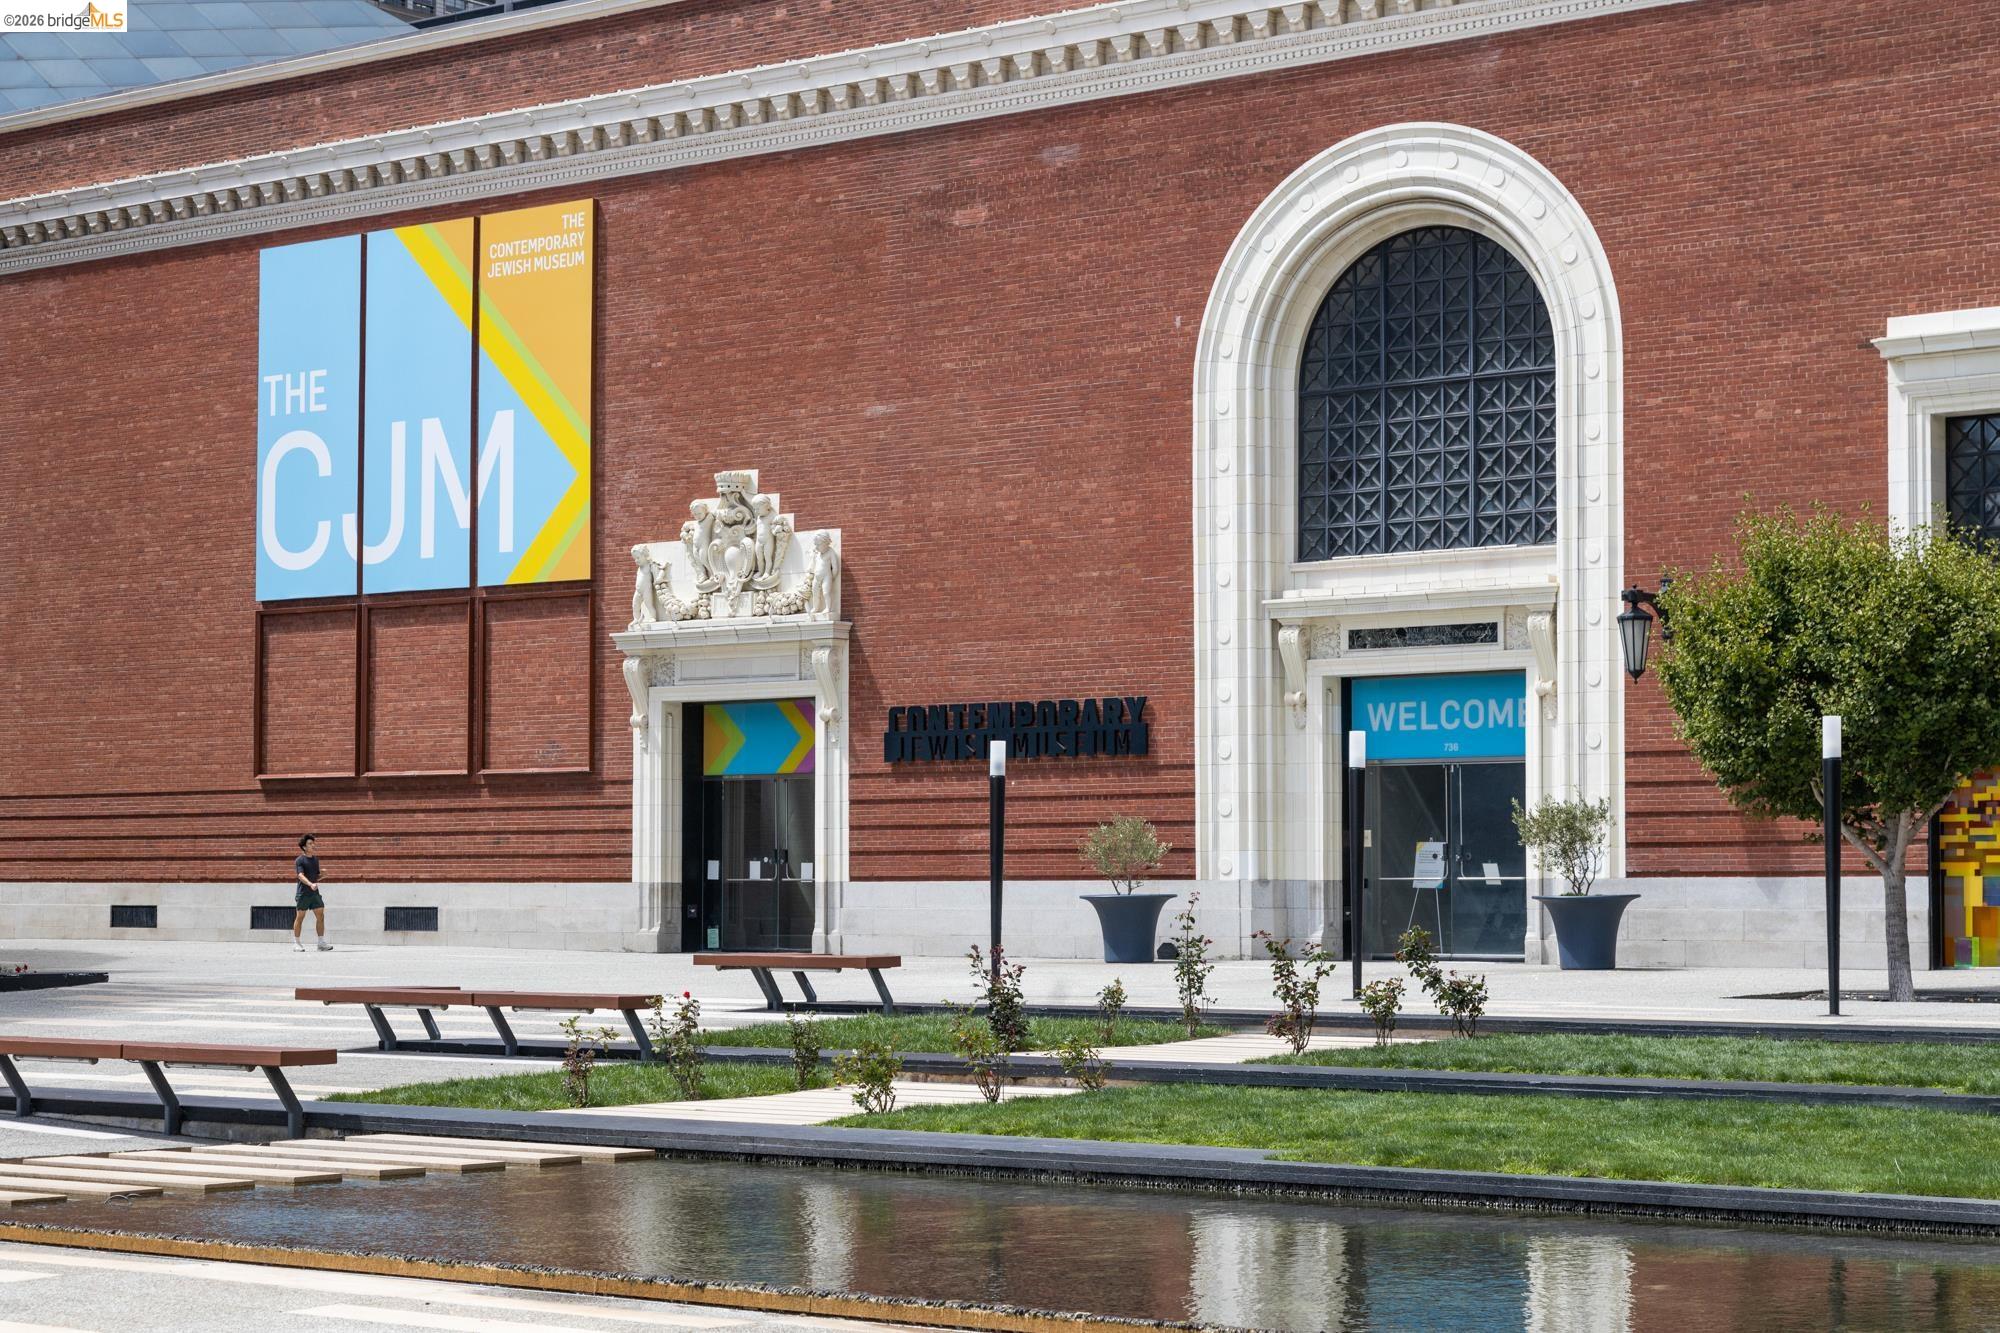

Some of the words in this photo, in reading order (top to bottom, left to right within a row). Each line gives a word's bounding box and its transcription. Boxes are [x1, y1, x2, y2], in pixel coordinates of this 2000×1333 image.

[561, 211, 585, 229] THE
[489, 231, 585, 259] CONTEMPORARY
[487, 258, 532, 278] JEWISH
[533, 250, 585, 272] MUSEUM
[263, 369, 327, 417] THE
[261, 409, 515, 571] CJM
[888, 696, 1148, 732] CONTEMPORARY
[1012, 729, 1131, 759] MUSEUM
